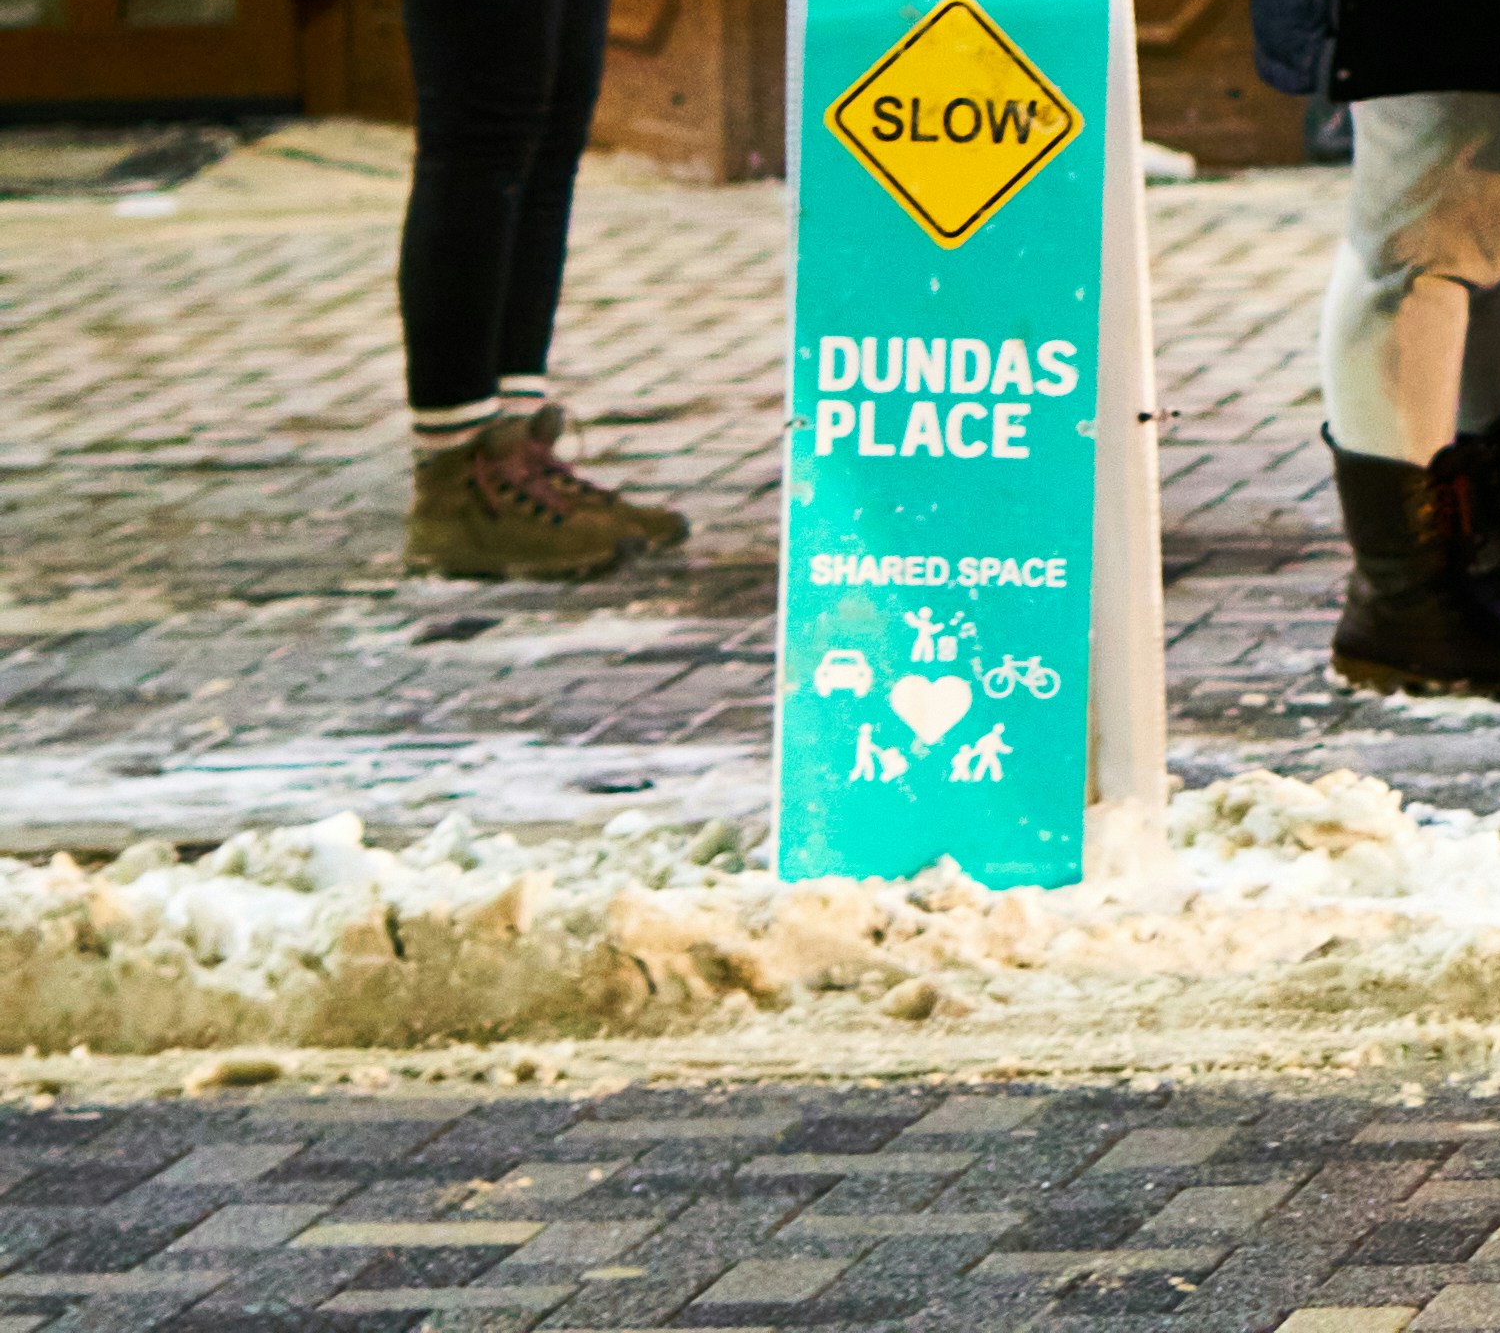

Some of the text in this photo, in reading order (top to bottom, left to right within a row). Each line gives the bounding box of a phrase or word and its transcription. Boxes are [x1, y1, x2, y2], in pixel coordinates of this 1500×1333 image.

[872, 95, 1037, 145] SLOW
[817, 335, 1078, 397] DUNDAS
[814, 400, 1031, 459] PLACE
[810, 554, 1067, 588] SHARED SPACE
